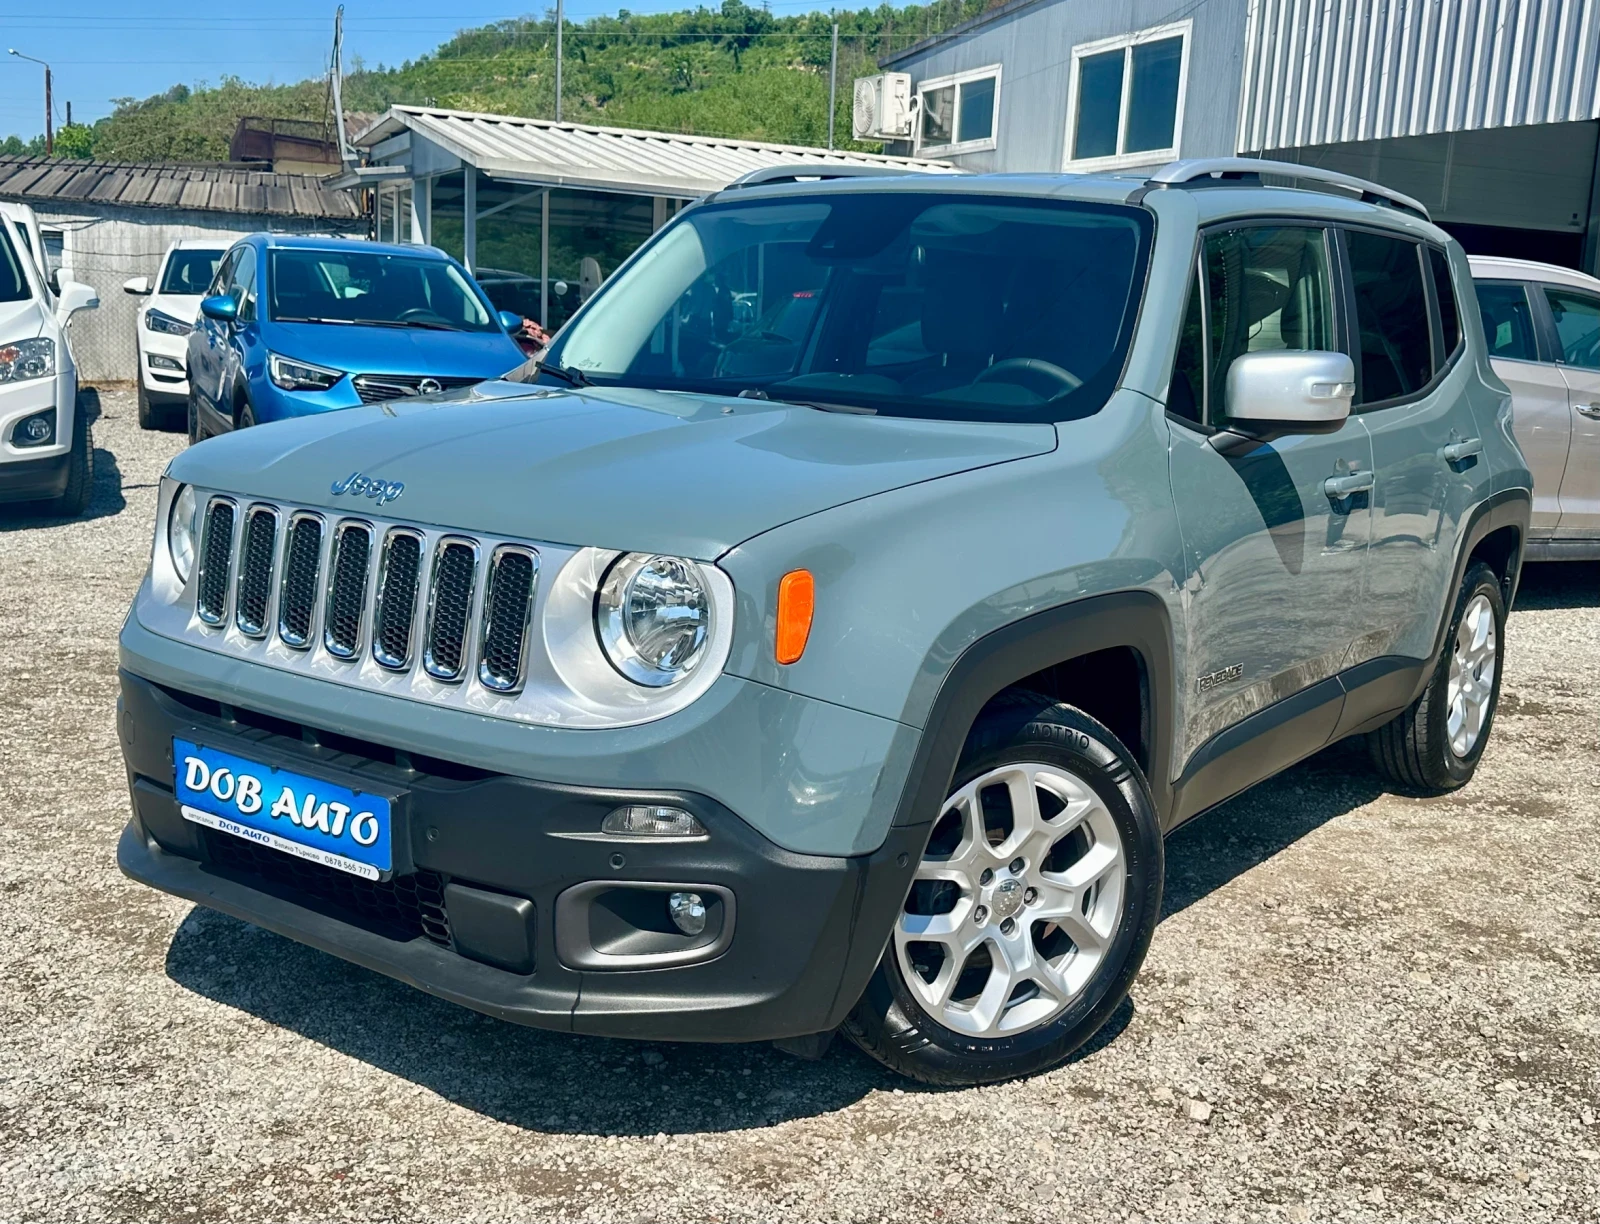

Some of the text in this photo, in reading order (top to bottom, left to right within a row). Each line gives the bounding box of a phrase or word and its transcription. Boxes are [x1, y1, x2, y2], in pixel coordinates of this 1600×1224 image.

[331, 472, 405, 507] Jeep
[184, 756, 379, 845] DOB AUTO
[219, 820, 270, 843] DOB AUTO
[324, 855, 342, 867] 0878
[359, 865, 371, 876] 777
